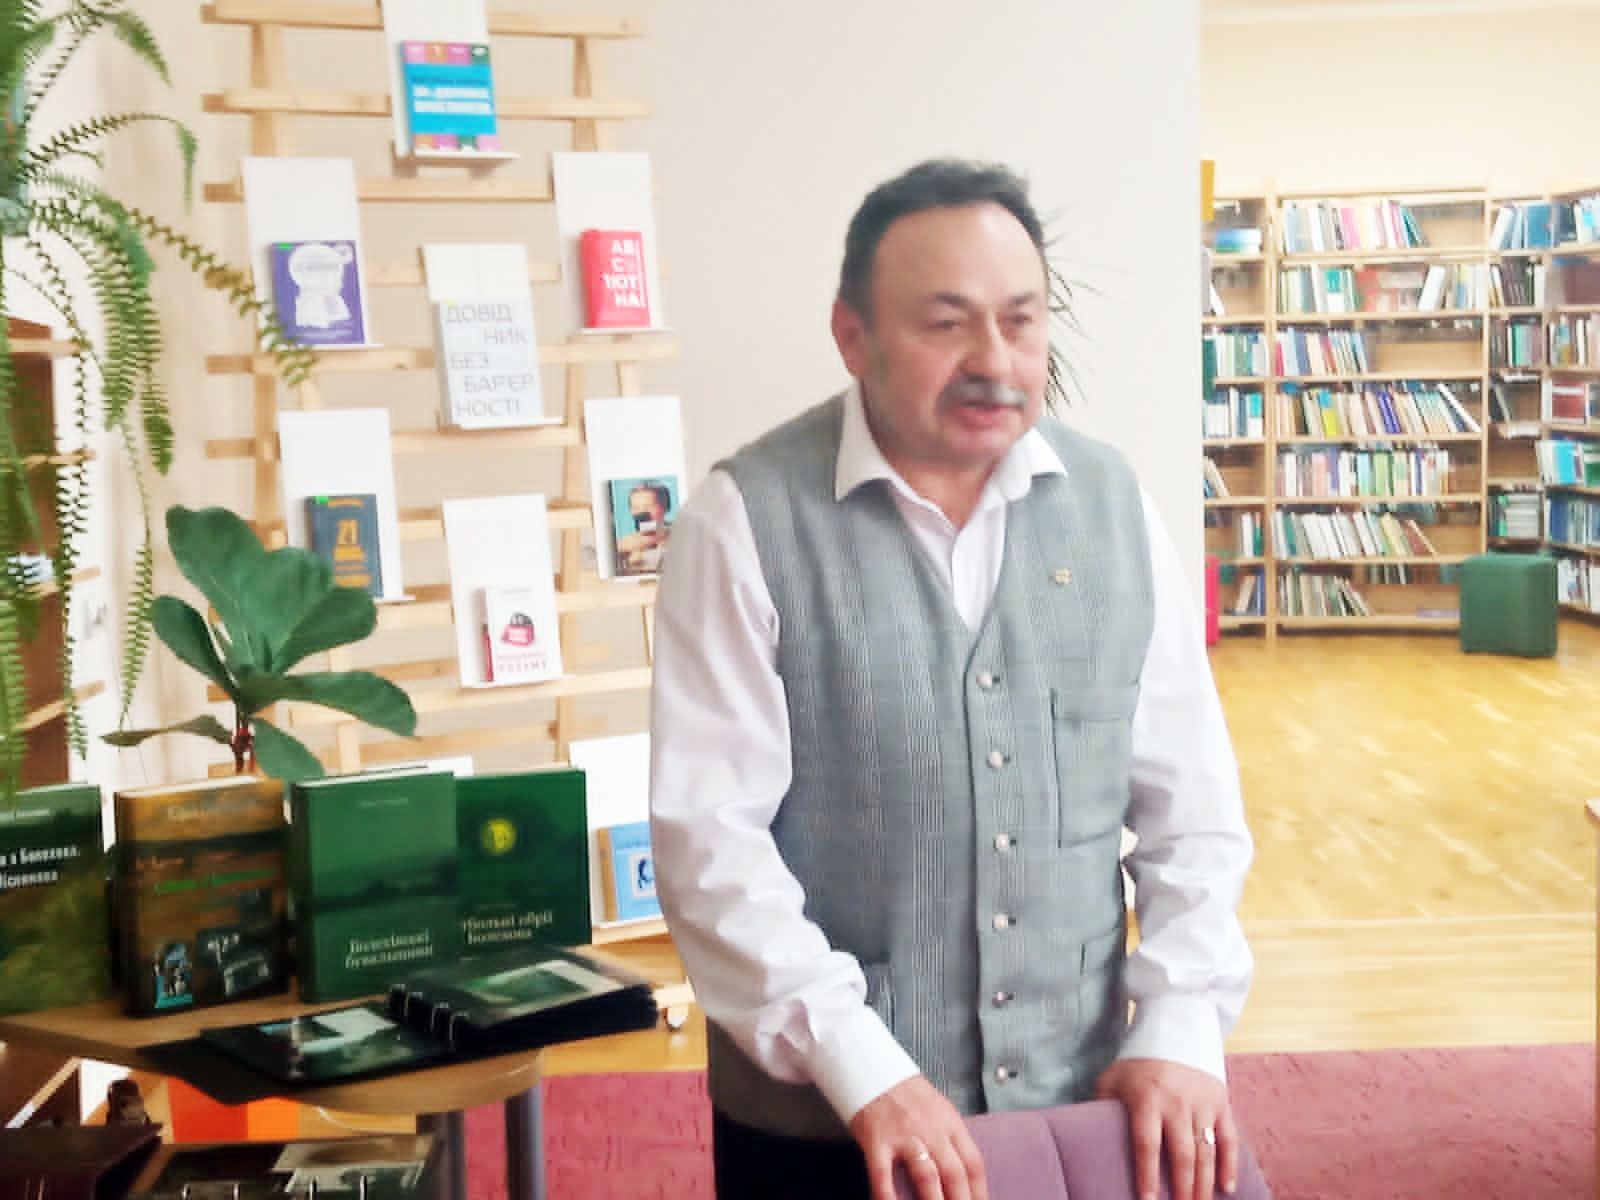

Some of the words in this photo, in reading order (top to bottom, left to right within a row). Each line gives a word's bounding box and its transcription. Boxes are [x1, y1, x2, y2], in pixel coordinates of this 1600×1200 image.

[446, 303, 513, 323] ДОВІД
[483, 327, 528, 344] НИК
[450, 351, 489, 369] БЕЗ
[455, 398, 520, 416] НОСТІ
